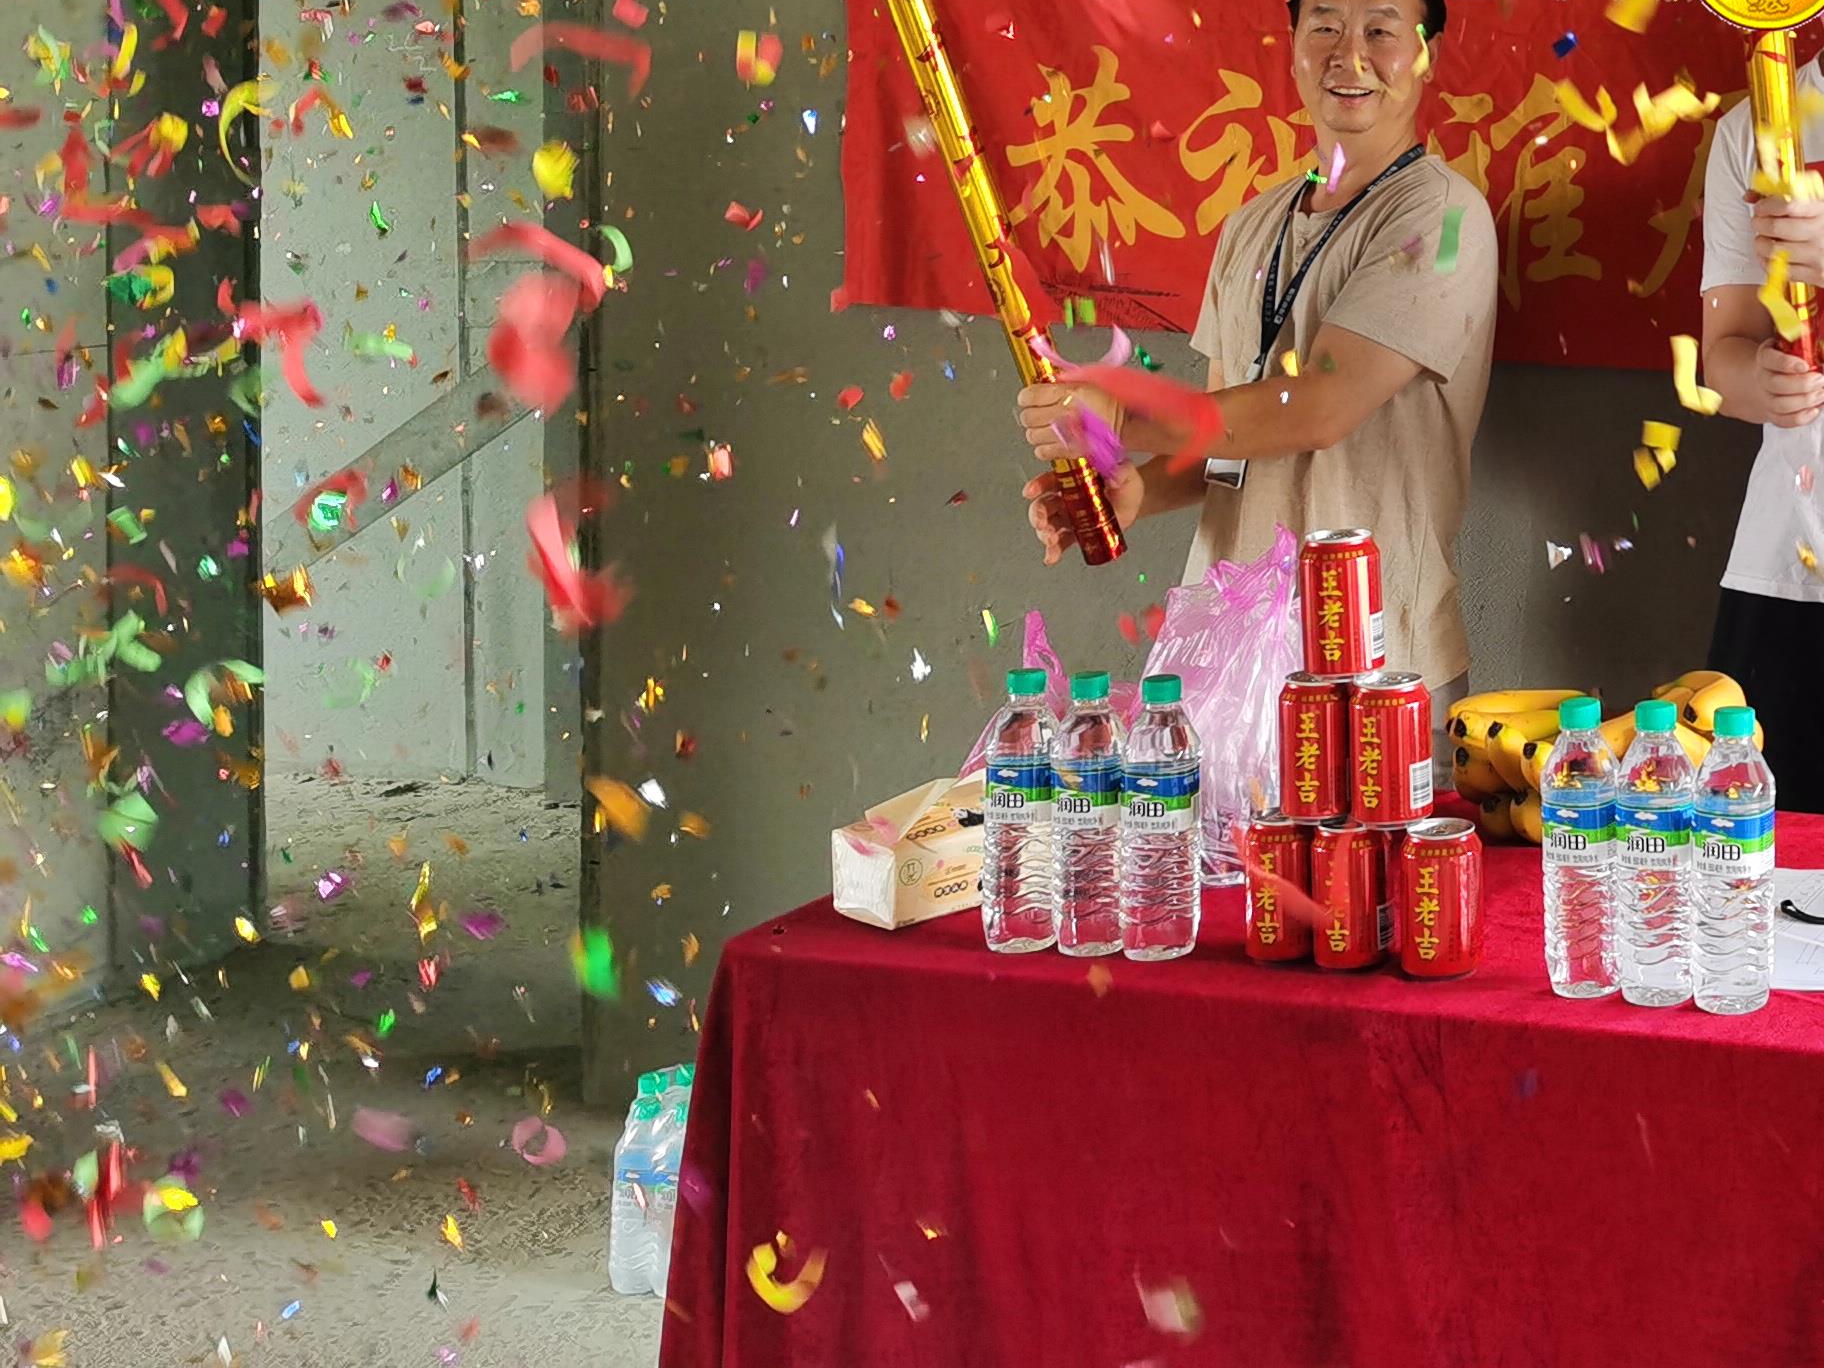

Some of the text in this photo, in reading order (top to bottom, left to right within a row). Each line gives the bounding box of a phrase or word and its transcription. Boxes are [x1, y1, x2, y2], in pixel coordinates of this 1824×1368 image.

[1318, 568, 1346, 662] 王老吉
[1295, 711, 1321, 804] 王老吉
[1359, 716, 1382, 809] 王老吉
[991, 792, 1025, 809] 润田
[1057, 797, 1091, 814] 润田
[1129, 801, 1165, 818] 润田
[1551, 832, 1586, 850] 润田
[1627, 836, 1665, 853] 润田
[1702, 840, 1741, 861] 润田
[1414, 865, 1441, 961] 王老吉
